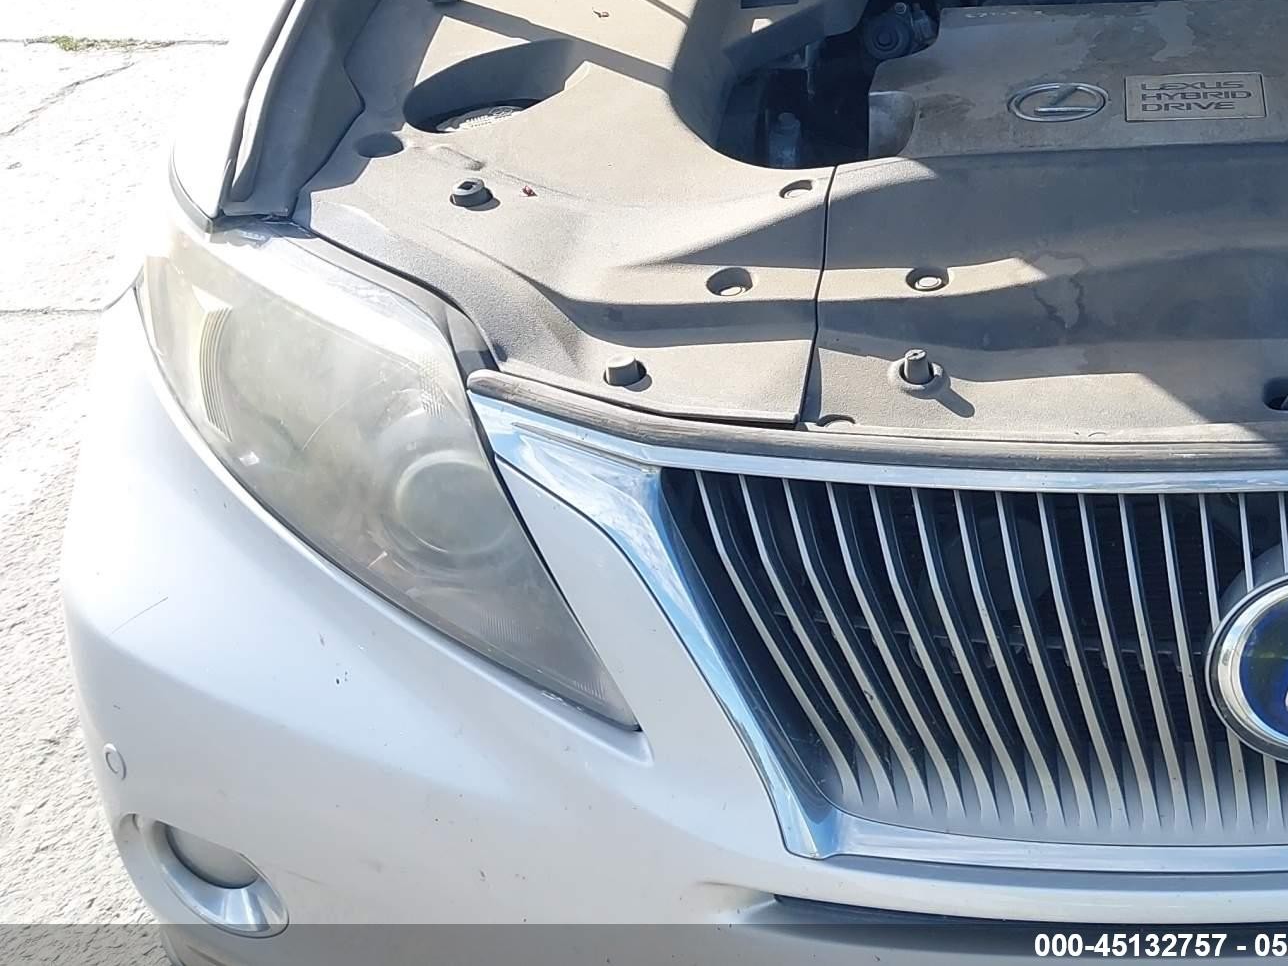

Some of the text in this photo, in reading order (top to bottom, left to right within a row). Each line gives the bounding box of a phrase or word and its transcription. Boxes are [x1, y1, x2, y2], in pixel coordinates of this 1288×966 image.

[1141, 80, 1245, 91] LEXUS
[1141, 90, 1252, 101] HYBRID
[1141, 101, 1236, 112] DRIVE
